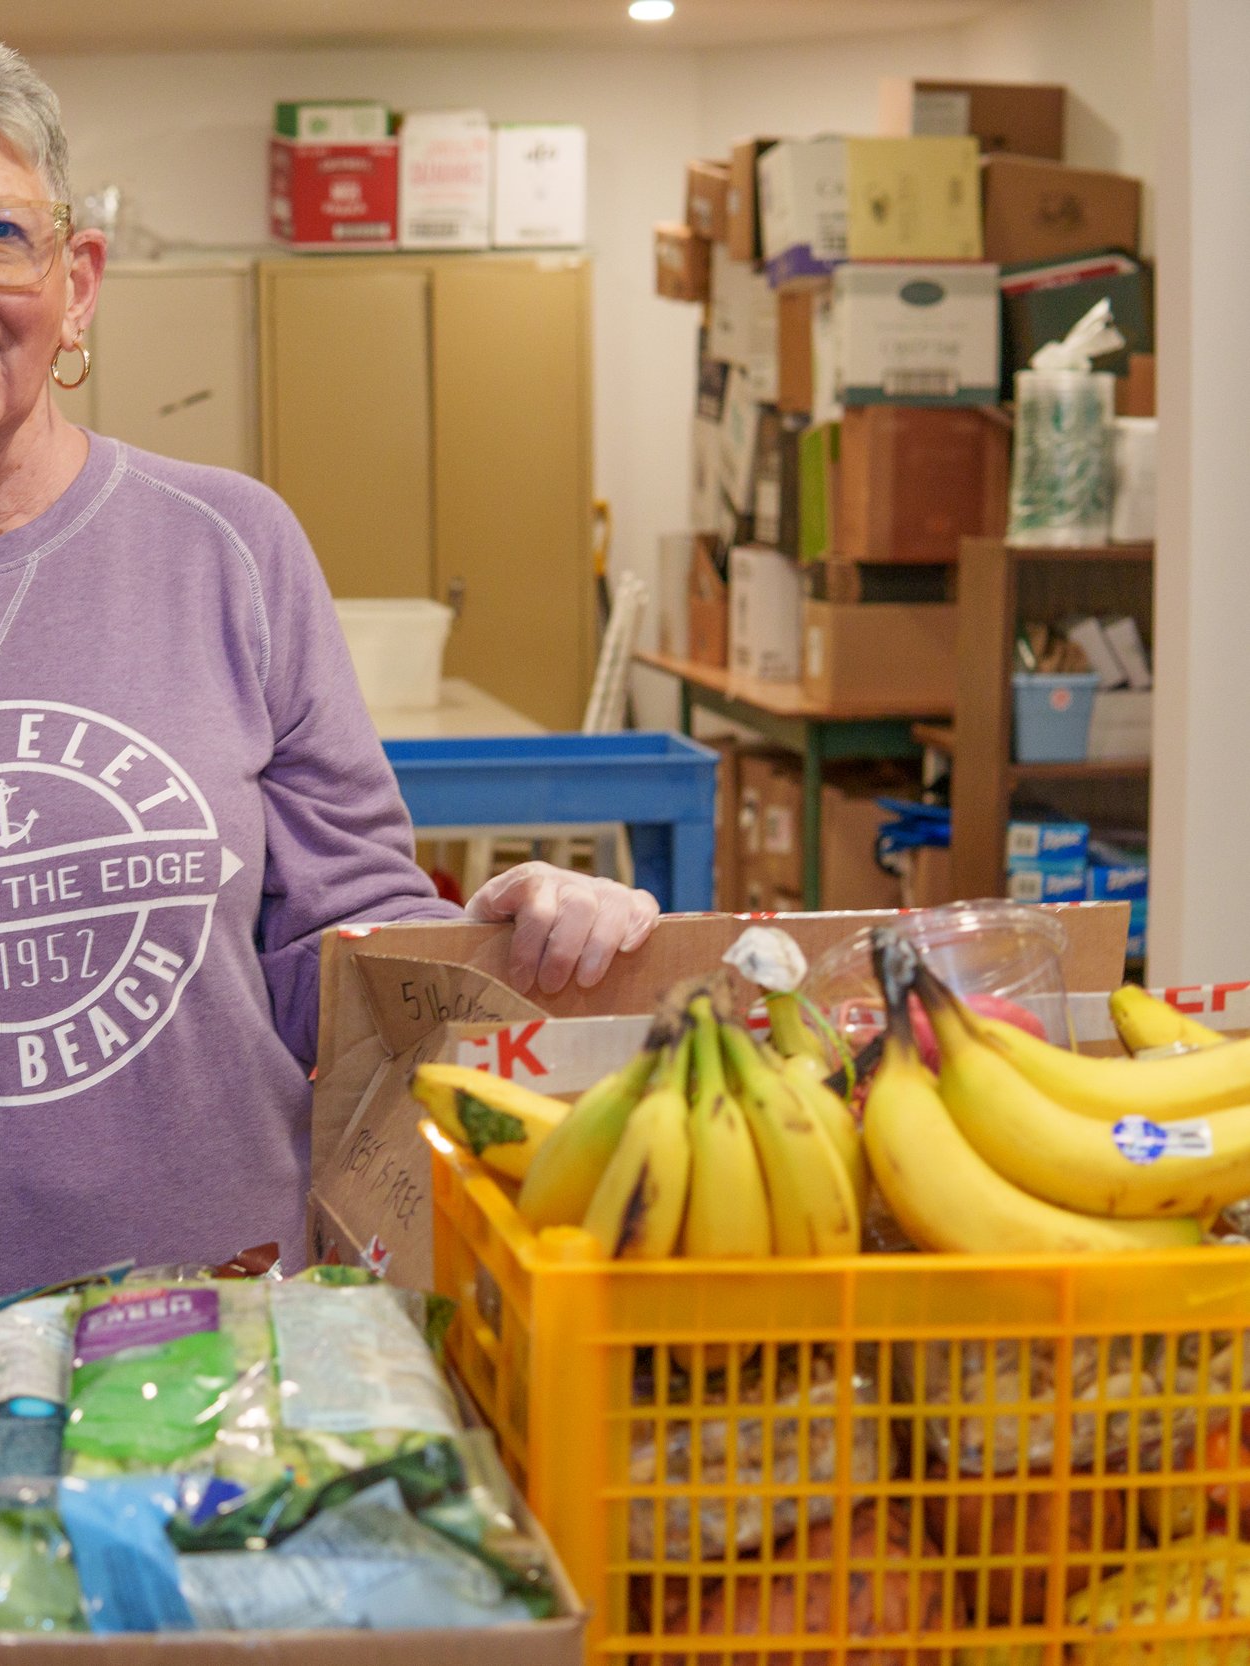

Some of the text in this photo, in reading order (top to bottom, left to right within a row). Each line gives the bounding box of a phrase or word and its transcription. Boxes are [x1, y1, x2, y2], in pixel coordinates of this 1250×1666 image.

[2, 865, 83, 909] THE
[100, 851, 206, 893] EDGE
[16, 939, 185, 1088] BEACH
